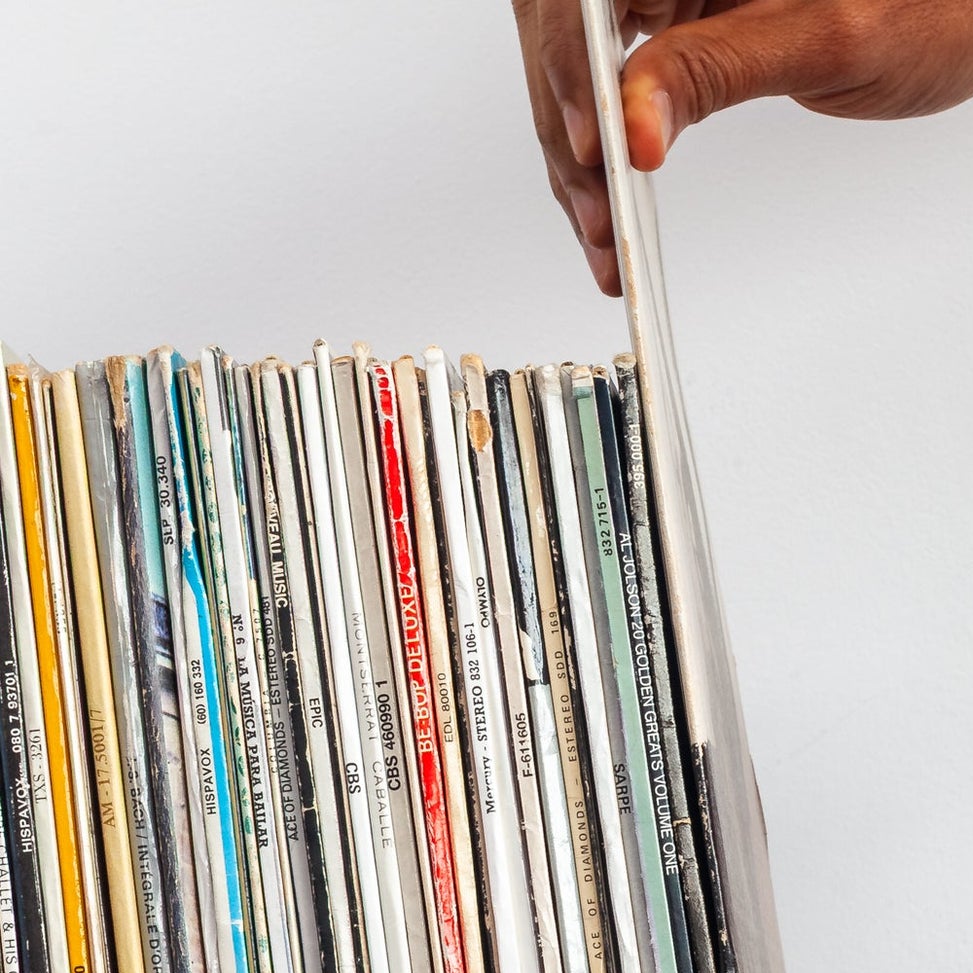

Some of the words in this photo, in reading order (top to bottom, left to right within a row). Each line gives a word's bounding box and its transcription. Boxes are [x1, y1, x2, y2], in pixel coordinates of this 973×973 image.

[156, 456, 170, 508] 30.340
[631, 463, 644, 489] 395
[594, 487, 609, 528] 715-1
[163, 519, 174, 545] SLP
[601, 529, 613, 557] 832
[619, 532, 632, 552] AL
[271, 561, 288, 609] MUSIC
[476, 577, 490, 628] OLYMPO
[622, 556, 641, 618] JOLSON
[464, 622, 477, 656] 106-1
[549, 611, 559, 634] 169
[632, 620, 644, 640] 20
[191, 659, 202, 679] 332
[264, 647, 282, 706] ESTEREO
[467, 659, 480, 681] 832
[552, 650, 566, 679] SDD
[635, 643, 655, 707] GOLDEN
[6, 674, 19, 710] 93701
[194, 681, 205, 700] 160
[437, 672, 450, 712] 80010
[197, 703, 208, 725] (60)
[240, 684, 257, 741] MÚSICA
[308, 697, 323, 728] EPIC
[377, 693, 396, 751] 460990
[443, 716, 454, 743] EDL
[472, 685, 488, 742] STEREO
[561, 694, 577, 763] ESTEREO
[12, 727, 22, 753] 080
[28, 728, 43, 761] 3261
[90, 709, 112, 787] 17.5001/7
[274, 722, 293, 794] DIAMONDS
[514, 712, 533, 777] F-611605
[643, 710, 664, 771] GREATS
[200, 747, 217, 815] HISPAVOX
[248, 745, 262, 787] PARA
[345, 762, 361, 794] CBS
[385, 755, 400, 790] CBS
[32, 773, 47, 805] TXS
[371, 760, 393, 849] CABALLE
[613, 763, 632, 814] SARPE
[654, 774, 674, 838] VOLUME
[15, 777, 33, 853] HISPAVOX
[101, 801, 117, 827] AM
[253, 790, 269, 849] BAILAR
[575, 801, 593, 883] DIAMONDS
[662, 842, 679, 876] ONE
[137, 844, 158, 936] INTÉGRALE
[588, 898, 598, 917] OF
[3, 922, 14, 933] &
[591, 931, 603, 960] ACE
[4, 938, 17, 965] HIS
